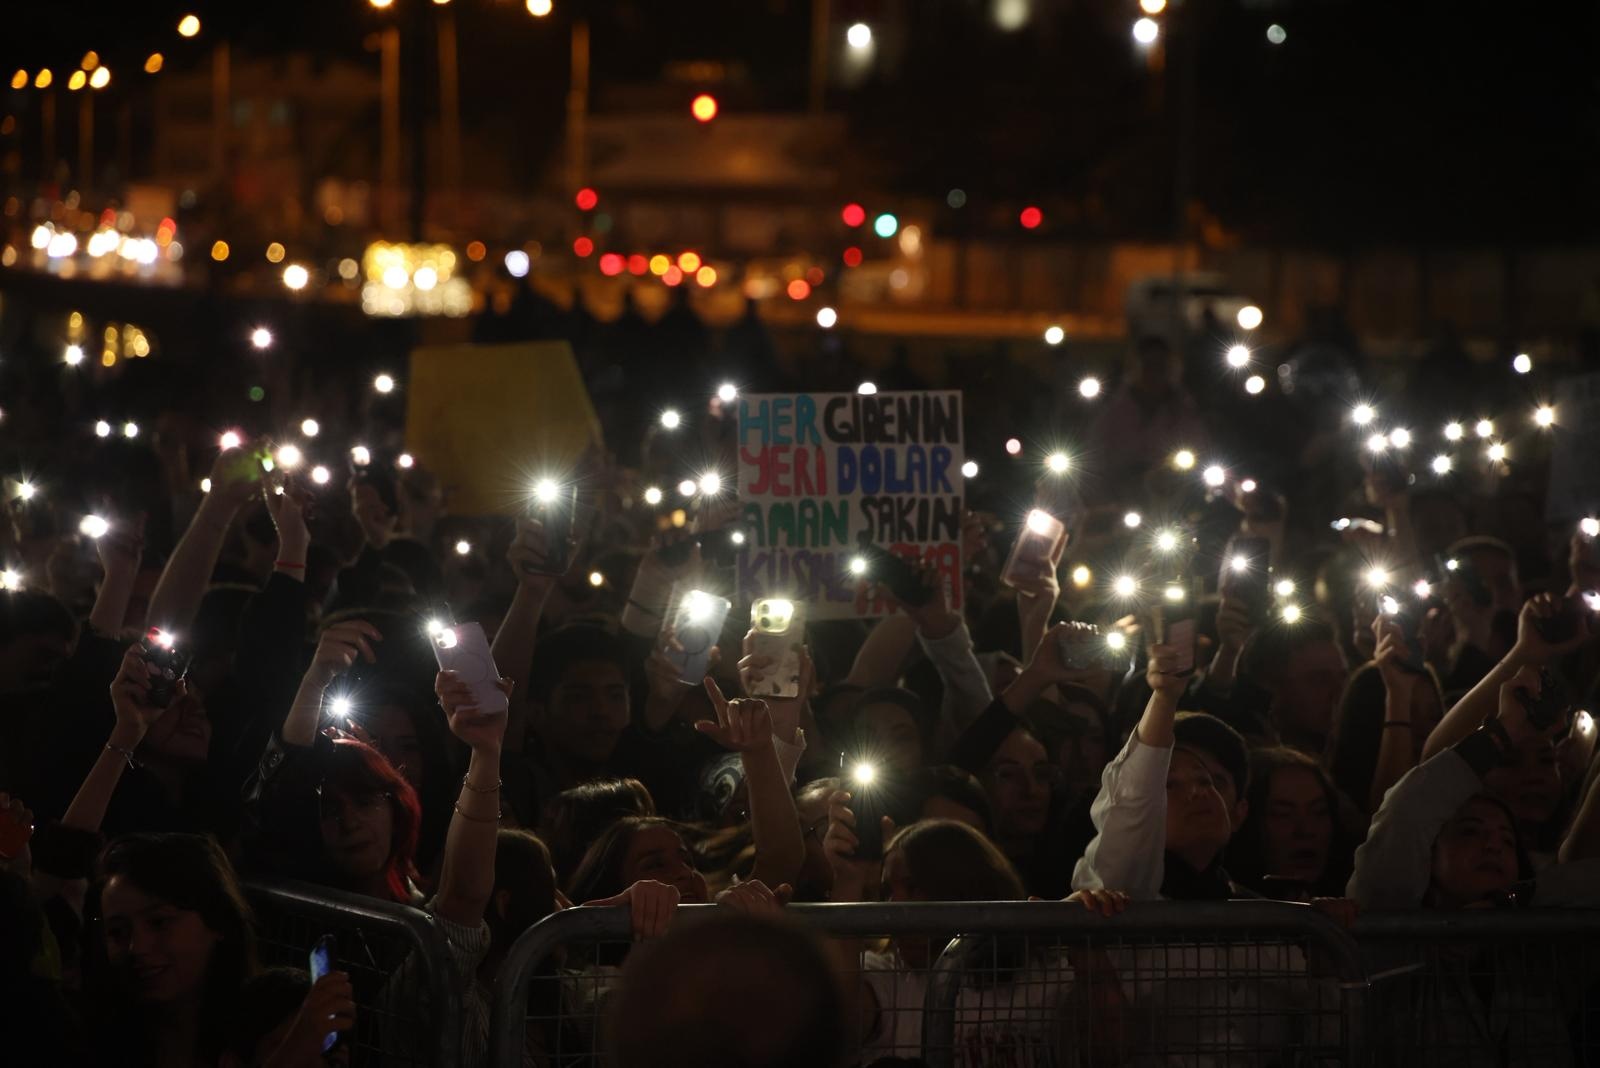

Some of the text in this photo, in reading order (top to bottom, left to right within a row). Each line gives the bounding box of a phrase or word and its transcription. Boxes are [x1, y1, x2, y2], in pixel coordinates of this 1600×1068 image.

[740, 395, 821, 444] HER
[837, 444, 953, 495] DOLAR
[744, 497, 960, 547] AMAN SAKIN
